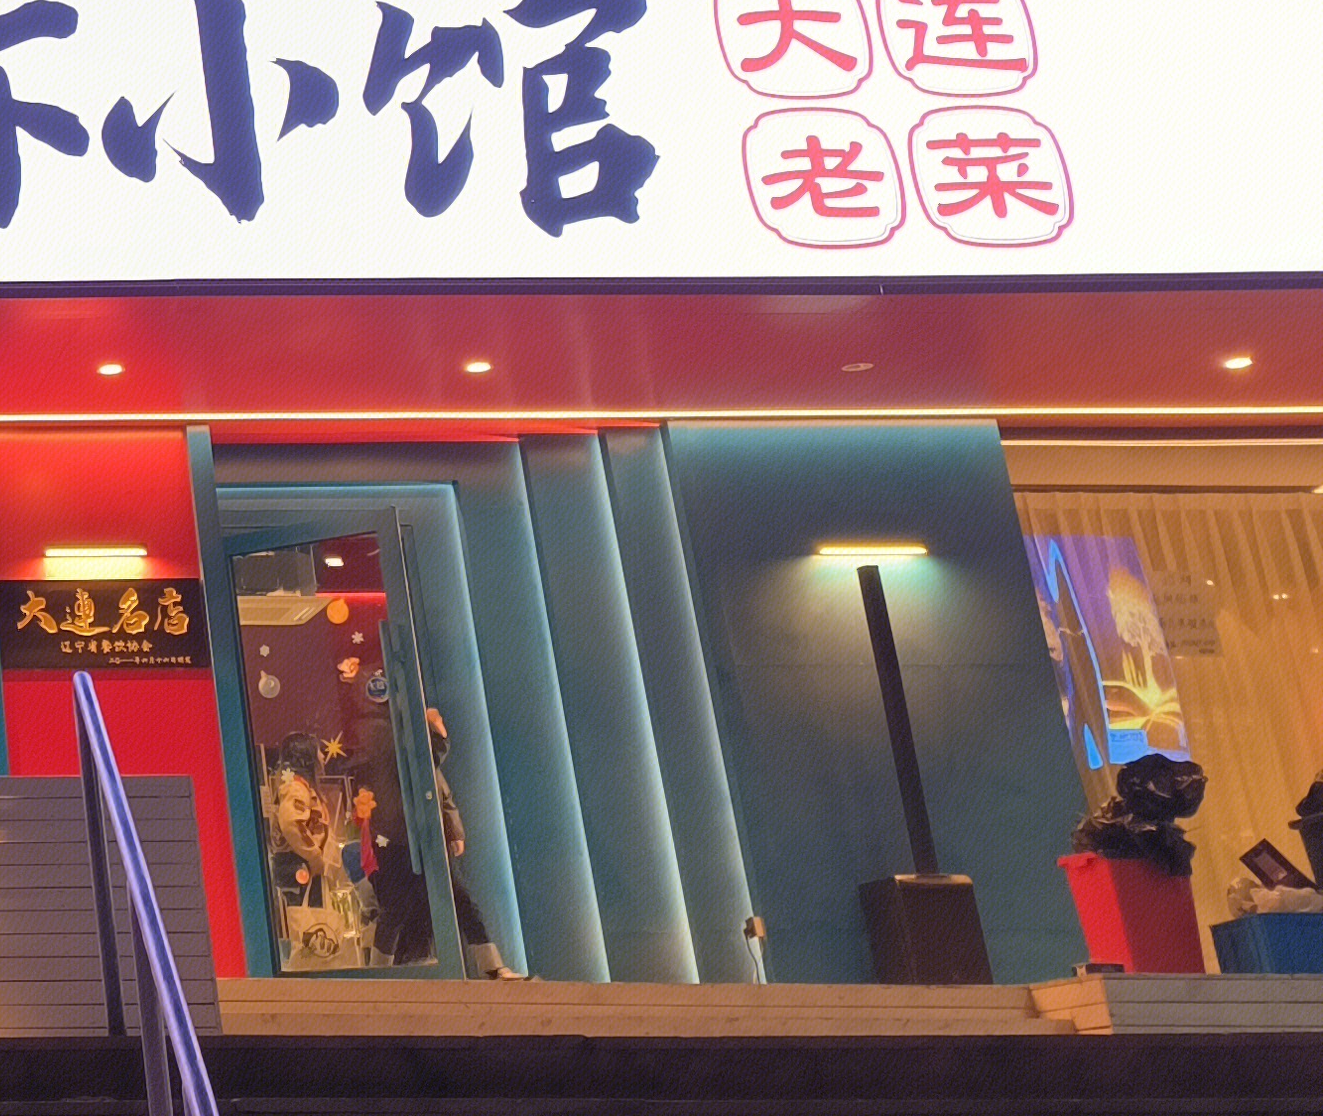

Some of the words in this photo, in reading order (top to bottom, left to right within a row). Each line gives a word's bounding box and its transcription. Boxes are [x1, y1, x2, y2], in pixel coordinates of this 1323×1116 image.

[761, 131, 1060, 219] 老菜
[60, 638, 153, 654] 辽宁省餐饮协会
